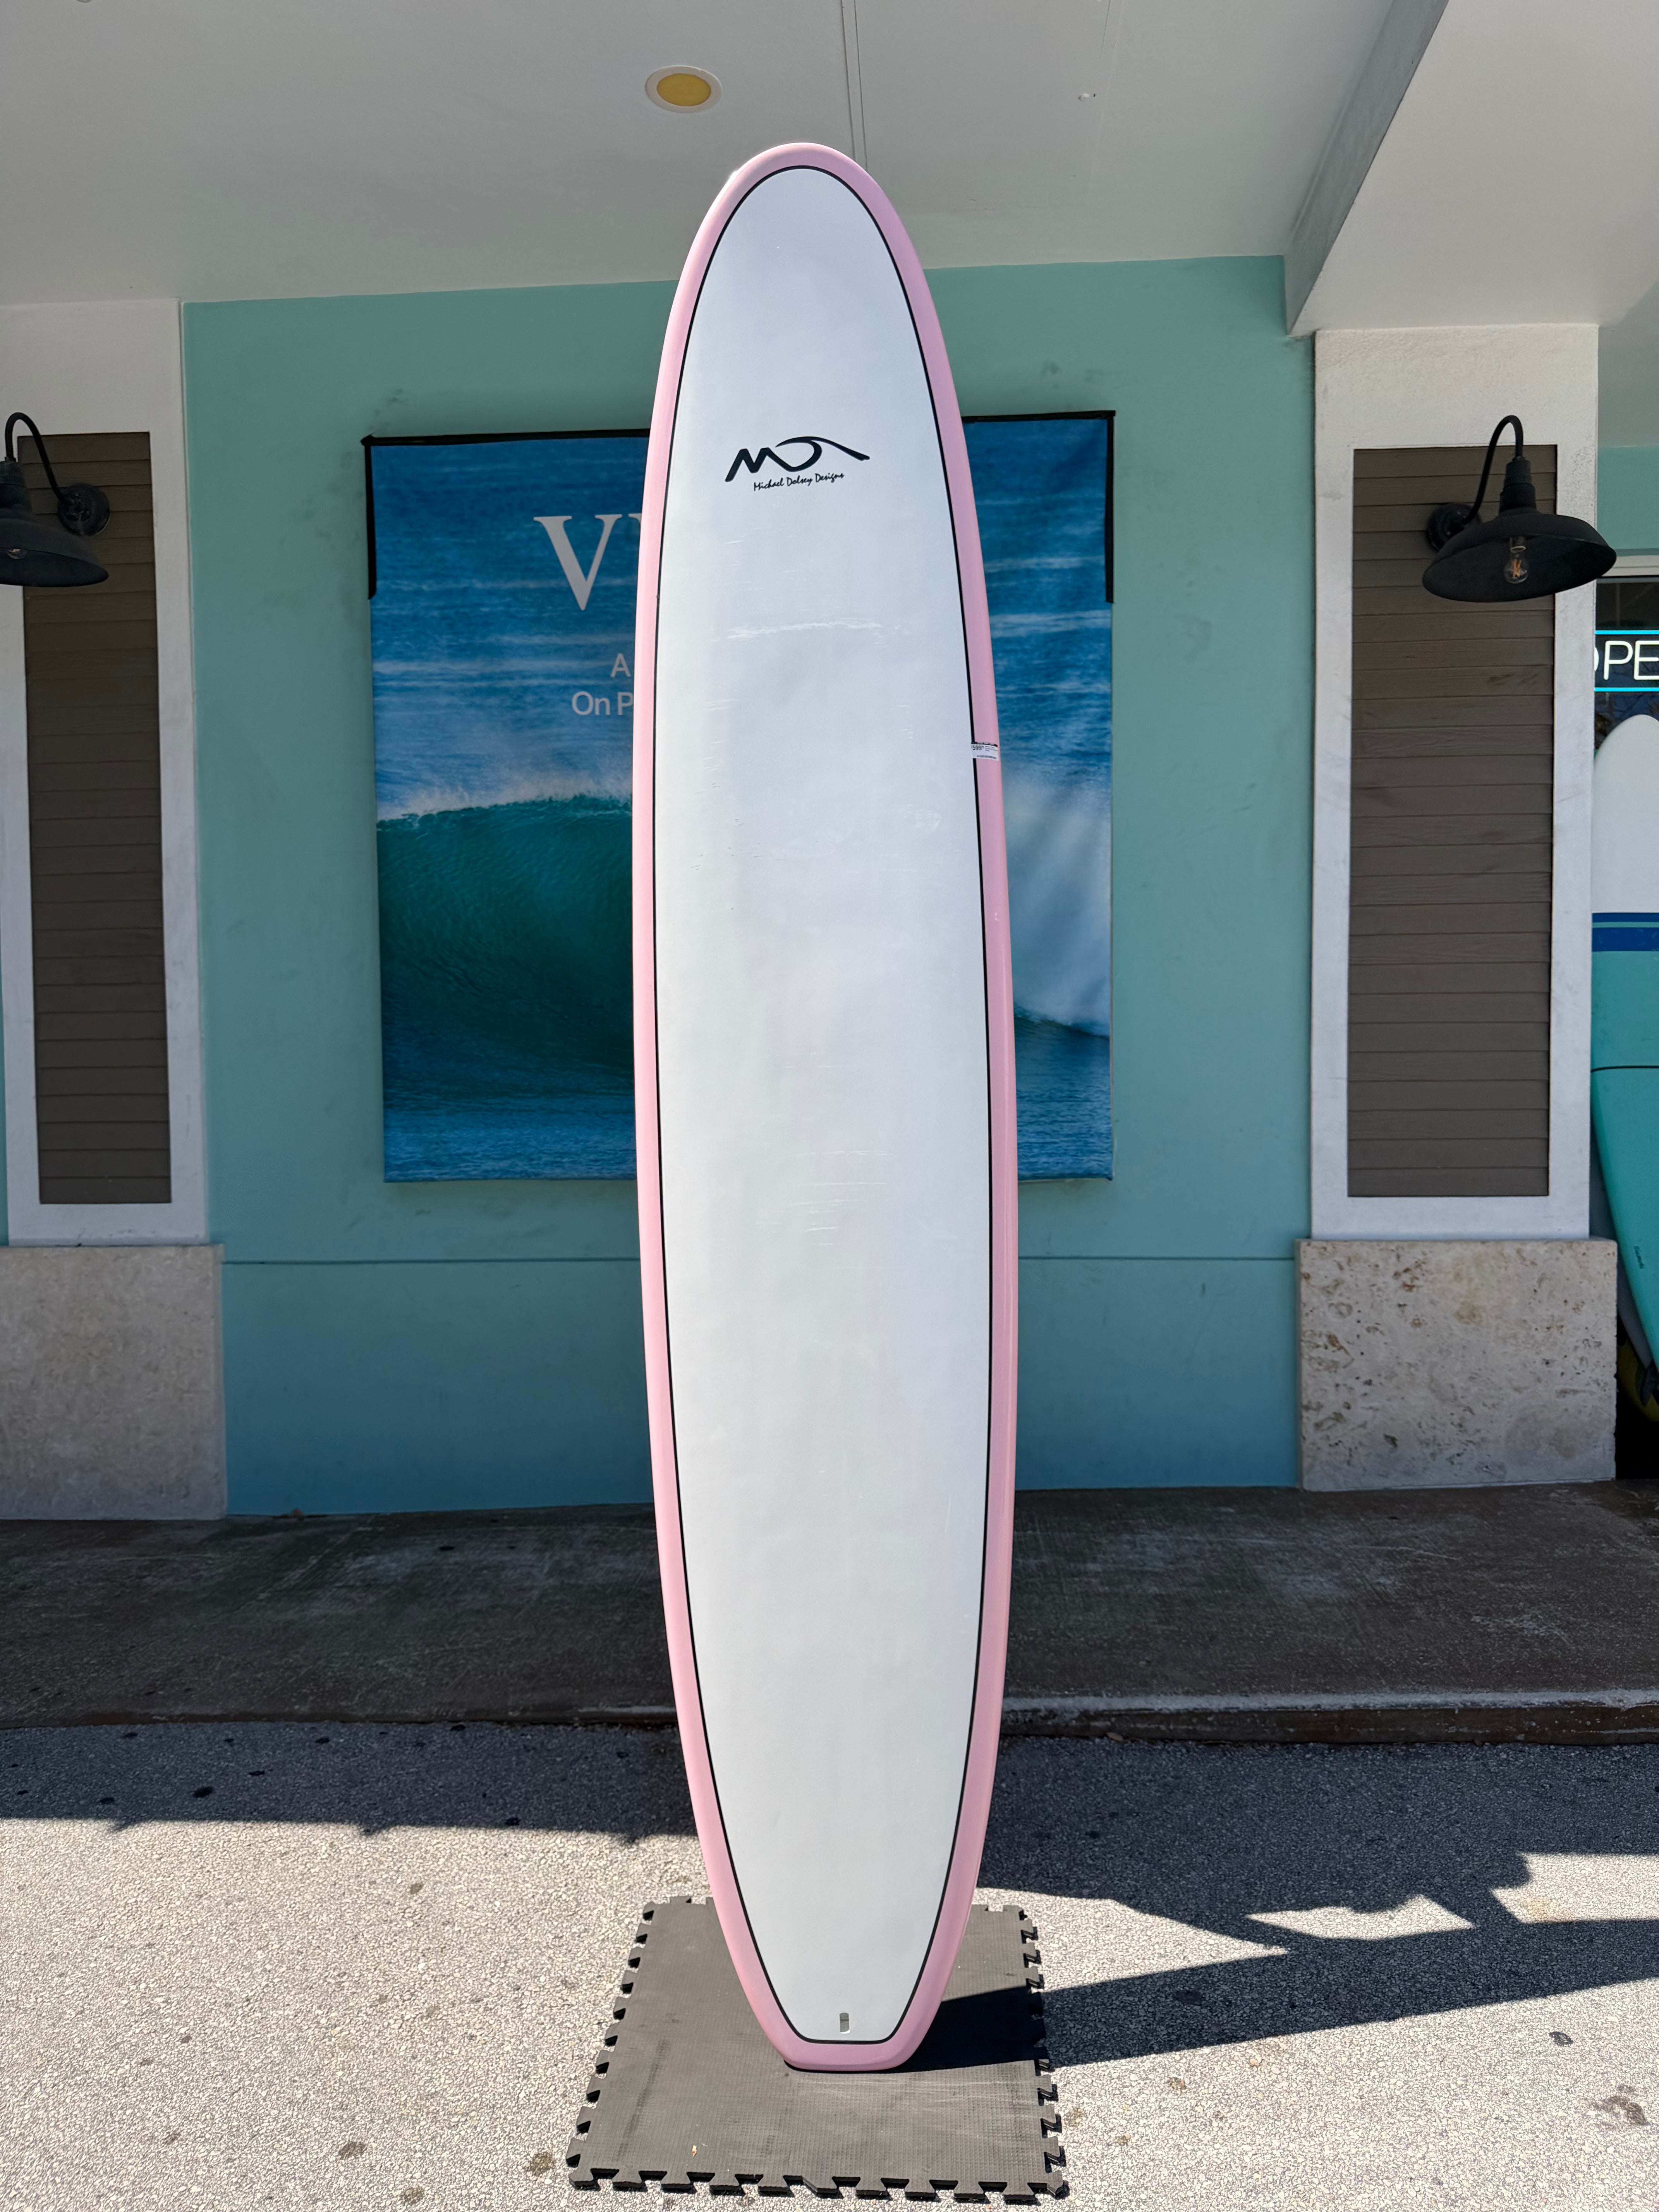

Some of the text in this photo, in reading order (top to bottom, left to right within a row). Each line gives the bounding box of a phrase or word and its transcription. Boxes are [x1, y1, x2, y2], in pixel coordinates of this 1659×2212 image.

[754, 472, 845, 491] Michael Dolsey Designs
[533, 513, 642, 611] V
[1594, 640, 1659, 680] PE
[572, 691, 611, 716] On
